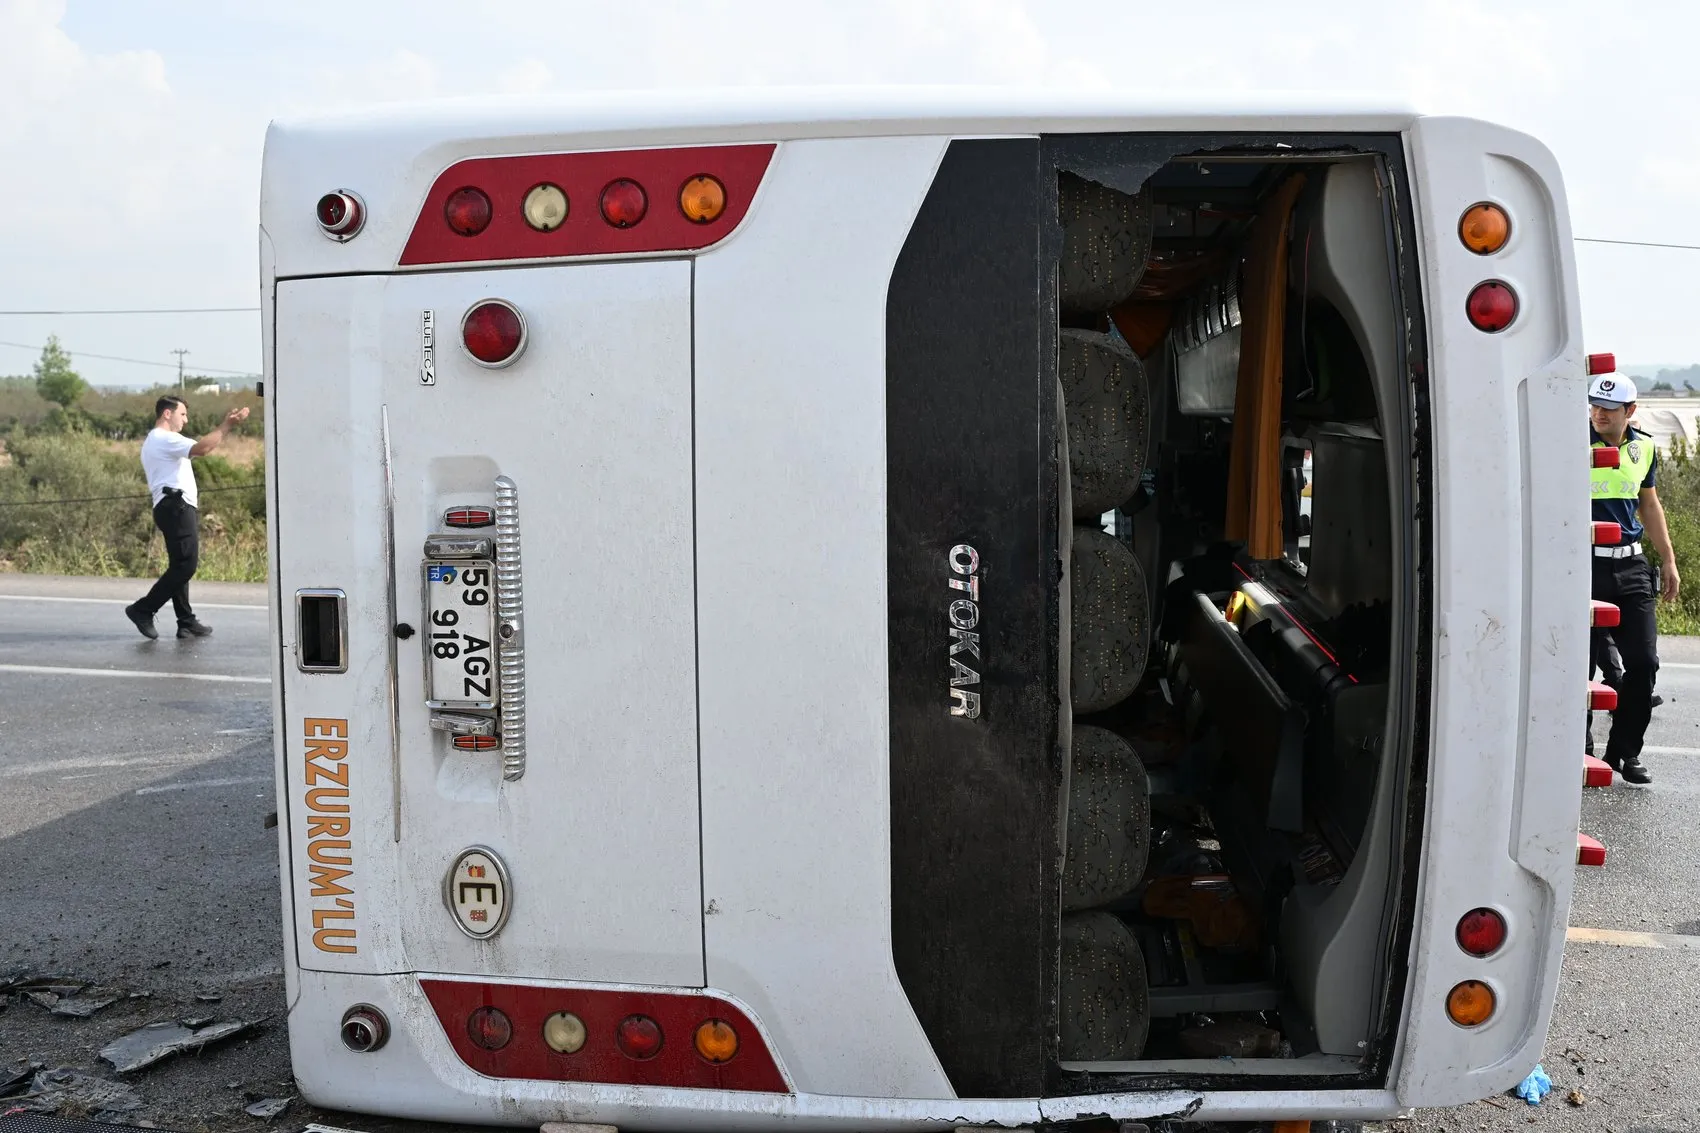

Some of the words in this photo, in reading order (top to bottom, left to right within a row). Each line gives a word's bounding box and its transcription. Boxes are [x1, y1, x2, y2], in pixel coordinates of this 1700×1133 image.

[430, 566, 440, 580] TR
[461, 568, 489, 606] 59
[432, 609, 459, 659] 918
[949, 544, 980, 719] OTOKAR
[463, 634, 491, 697] AGZ
[304, 718, 357, 954] ERZURUM'LU
[459, 882, 497, 905] E
